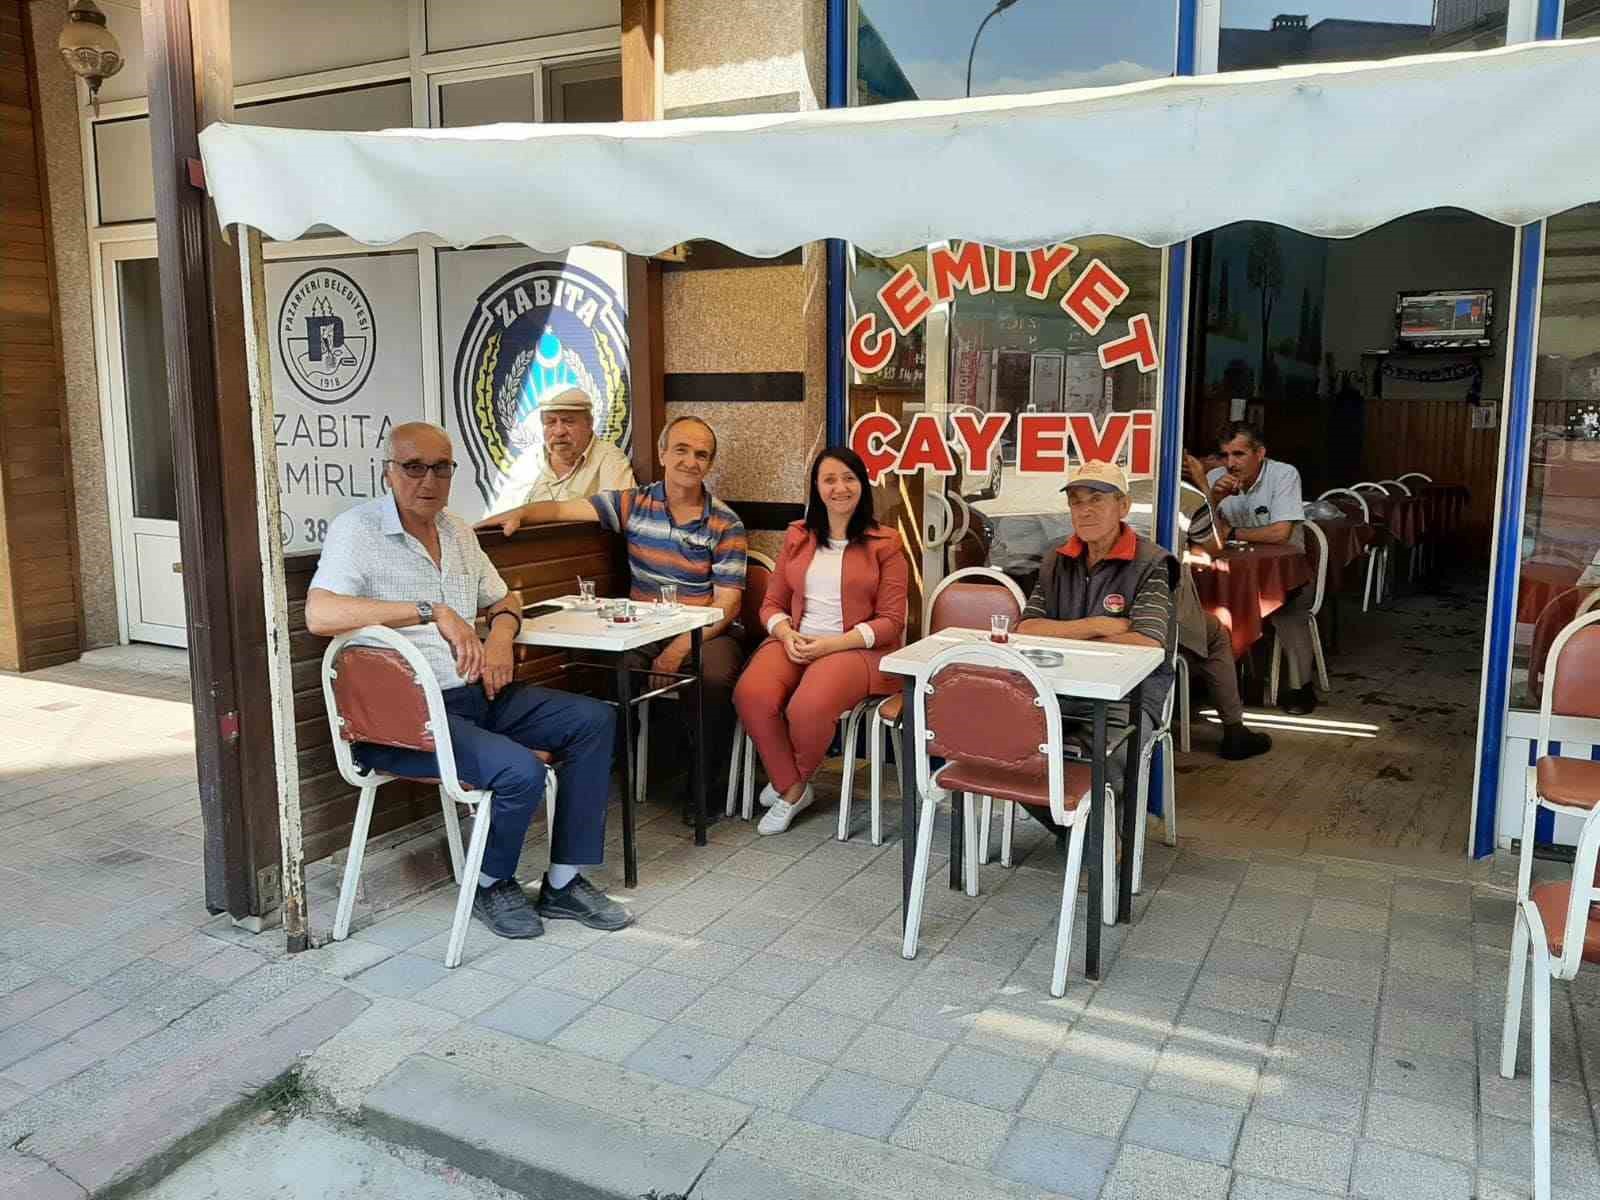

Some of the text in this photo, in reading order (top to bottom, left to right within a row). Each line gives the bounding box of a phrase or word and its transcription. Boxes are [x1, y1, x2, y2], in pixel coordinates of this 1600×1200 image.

[324, 278, 370, 331] BELEDİYESİ
[494, 279, 599, 329] ZABITA
[273, 413, 392, 449] ZABITA
[850, 411, 1012, 487] ÇAY
[280, 455, 388, 498] MİRLİ
